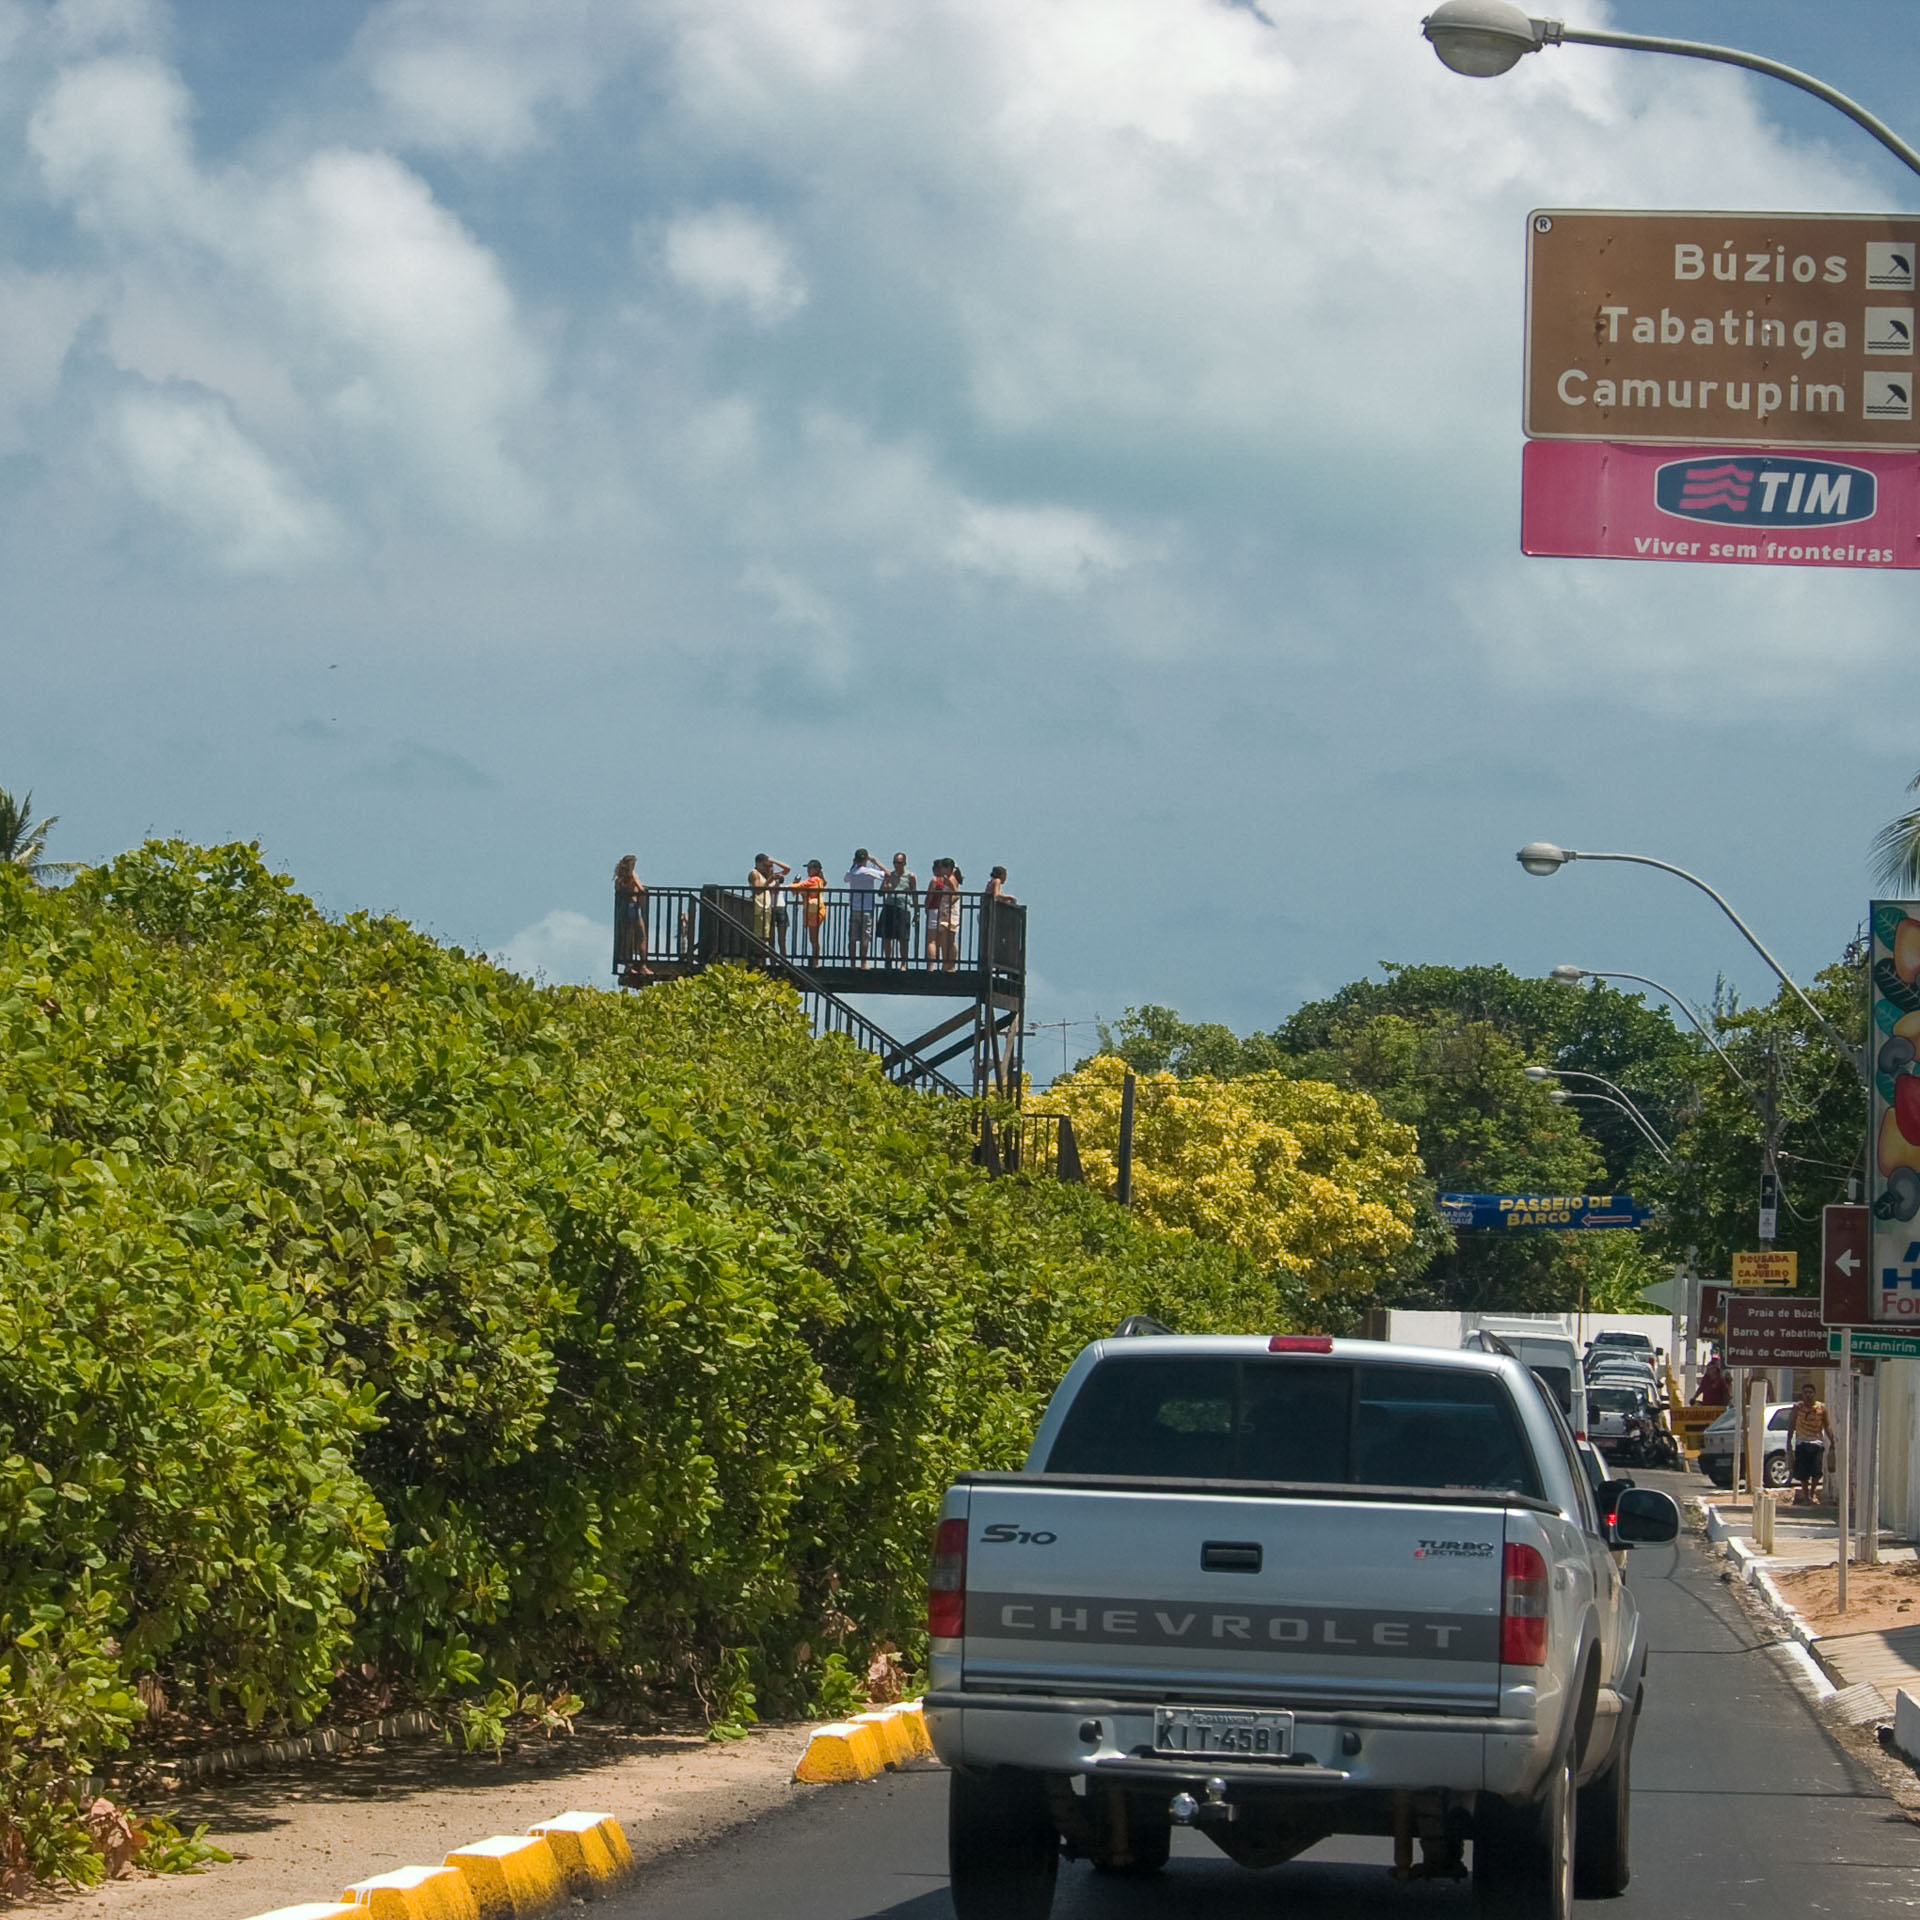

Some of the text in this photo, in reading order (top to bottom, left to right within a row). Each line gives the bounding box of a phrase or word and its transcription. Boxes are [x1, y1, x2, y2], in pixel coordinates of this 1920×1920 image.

[1674, 240, 1848, 283] Búzios
[1601, 306, 1847, 360] Tabatinga
[1557, 369, 1846, 420] Camurupim
[1758, 471, 1852, 516] TIM
[1634, 536, 1894, 563] Viver sem fronteiras
[1499, 1196, 1613, 1212] PASSEIO DE
[1506, 1211, 1571, 1226] BARCO
[1739, 1255, 1790, 1264] POUSADA
[1738, 1269, 1790, 1278] CAJUEIRO
[1748, 1308, 1774, 1318] Praia
[1778, 1308, 1790, 1318] de
[1732, 1327, 1828, 1340] Barra de Tabatinga
[1728, 1346, 1828, 1359] Praia de Camurupim
[1850, 1340, 1917, 1353] arnamirim
[979, 1523, 1058, 1545] S10
[1418, 1539, 1495, 1551] TURBO
[1001, 1604, 1463, 1650] CHEVROLET
[1157, 1723, 1286, 1753] KIT-4581
